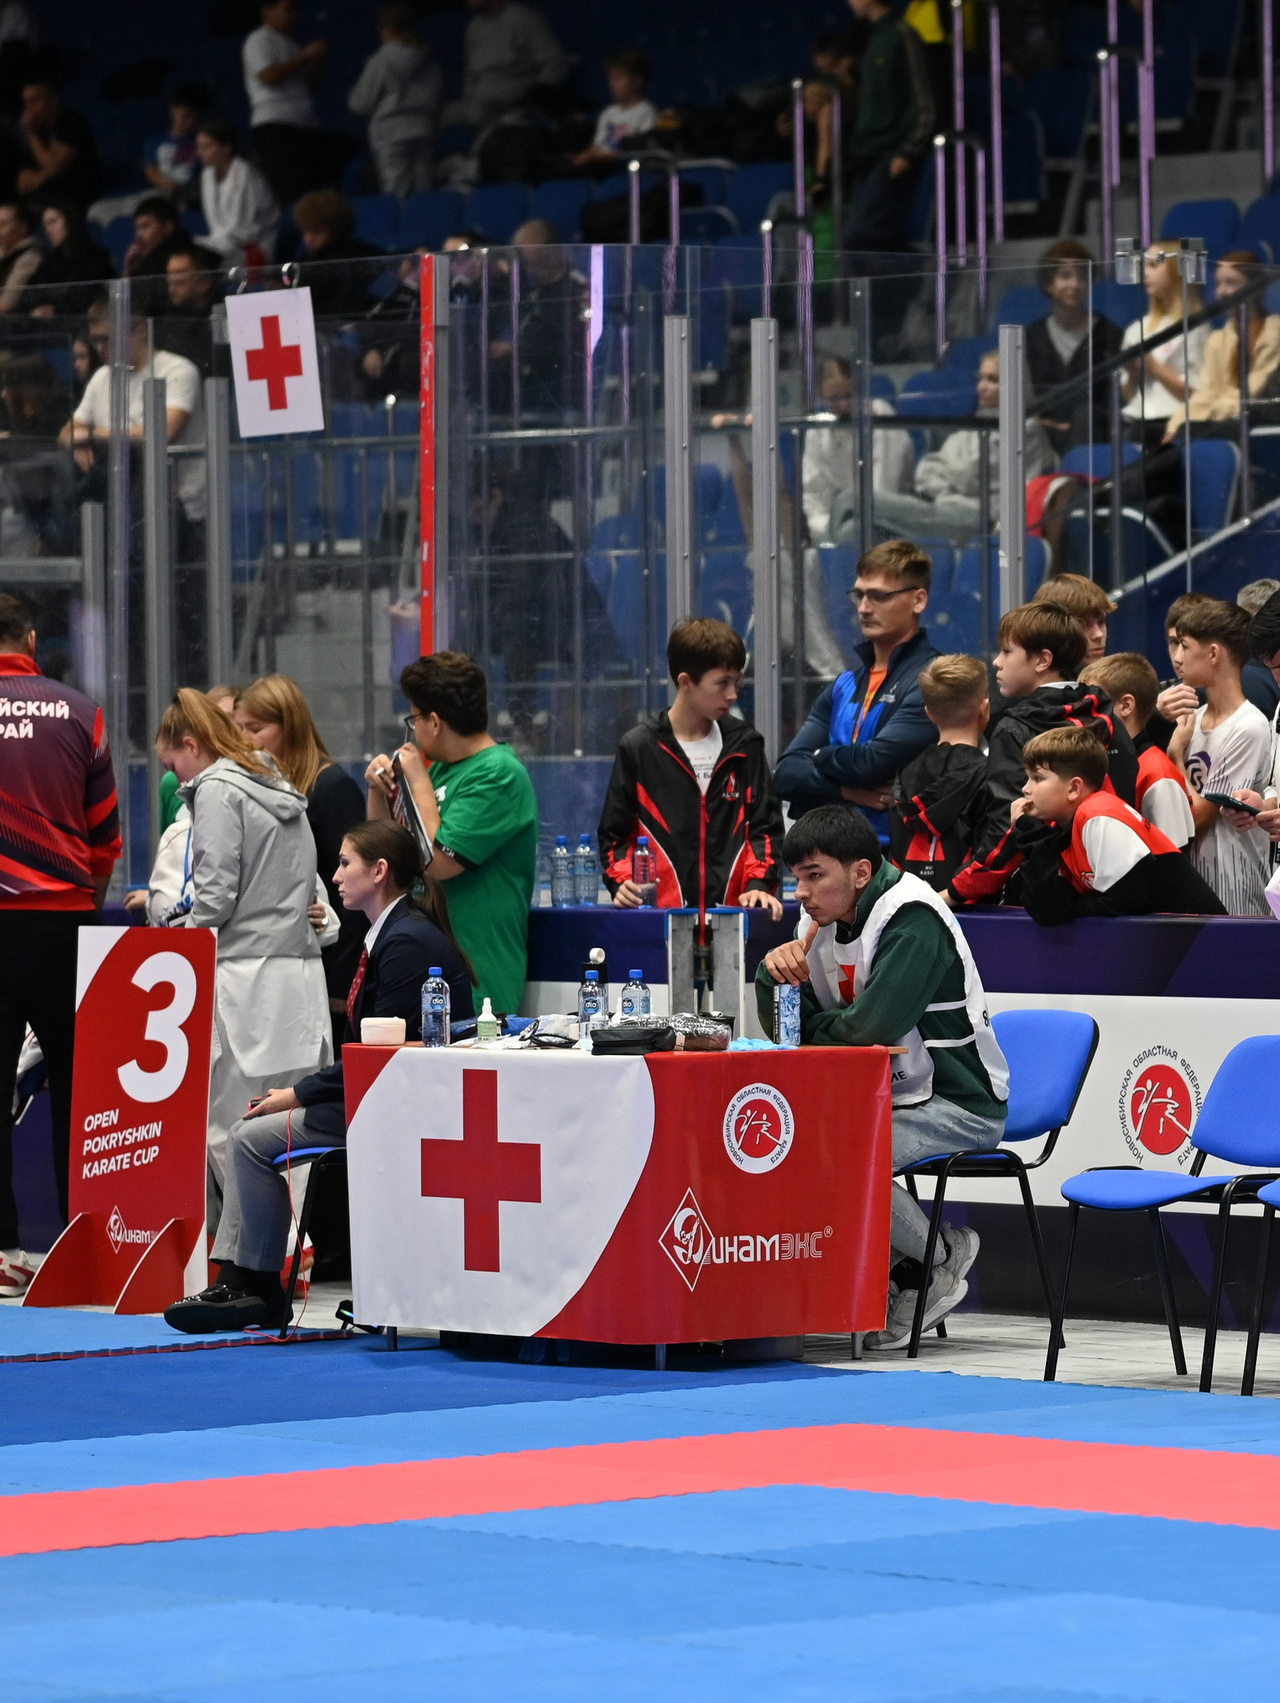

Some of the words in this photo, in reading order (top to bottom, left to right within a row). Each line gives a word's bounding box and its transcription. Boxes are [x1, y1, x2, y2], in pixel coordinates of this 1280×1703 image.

[117, 951, 198, 1103] 3
[1132, 1045, 1179, 1069] ОБЛАСТНАЯ
[736, 1086, 772, 1103] ОБЛАСТНАЯ
[1180, 1058, 1203, 1117] ФЕДЕРАЦ
[84, 1108, 120, 1133] OPEN
[772, 1094, 791, 1135] ФЕДЕРАЦИЯ
[1118, 1068, 1145, 1165] НОВОСИБИРСКАЯ
[82, 1120, 163, 1156] POKRYSHKIN
[725, 1103, 744, 1165] НОВОСИБИРСКАЯ
[770, 1139, 788, 1164] КАРАТЭ
[82, 1152, 132, 1180] KARATE
[133, 1145, 160, 1168] CUP
[1176, 1143, 1195, 1167] РАТЭ
